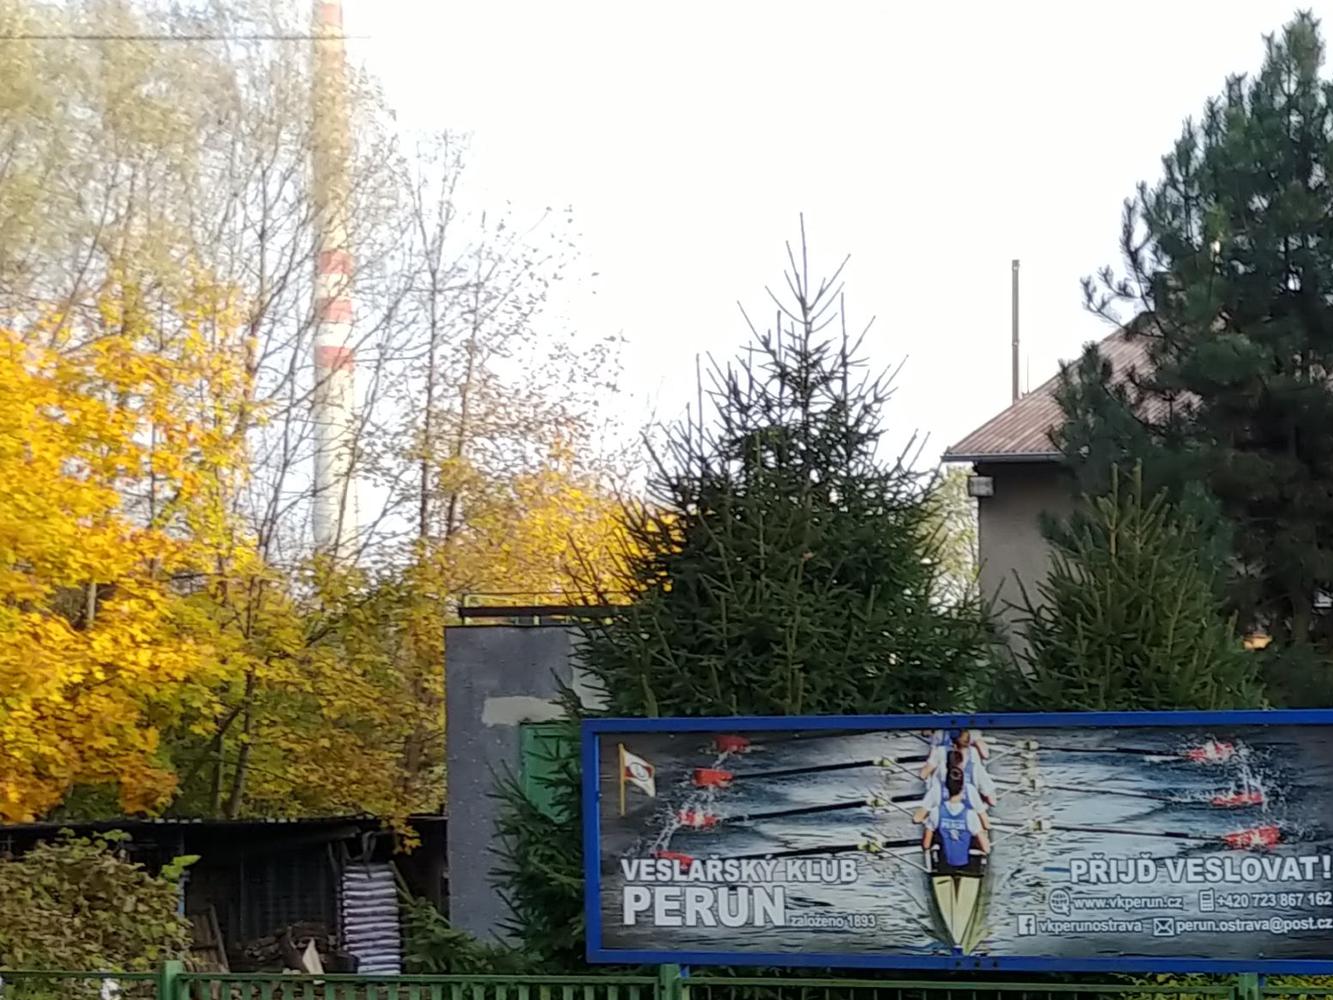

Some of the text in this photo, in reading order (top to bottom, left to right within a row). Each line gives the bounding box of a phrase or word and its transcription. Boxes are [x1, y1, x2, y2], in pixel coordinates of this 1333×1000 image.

[622, 855, 857, 881] VESLAŘSKÝ KLUB
[1071, 853, 1331, 882] PŘIJĎ VESLOVAT!
[624, 886, 785, 926] PERUN
[1074, 895, 1182, 910] www.vkperun.cz
[1218, 892, 1332, 907] +420 723 867 162
[791, 914, 875, 926] založeno 1893
[1040, 919, 1142, 933] vkperunostrava
[1177, 918, 1333, 934] perun.ostrava@post.cz
